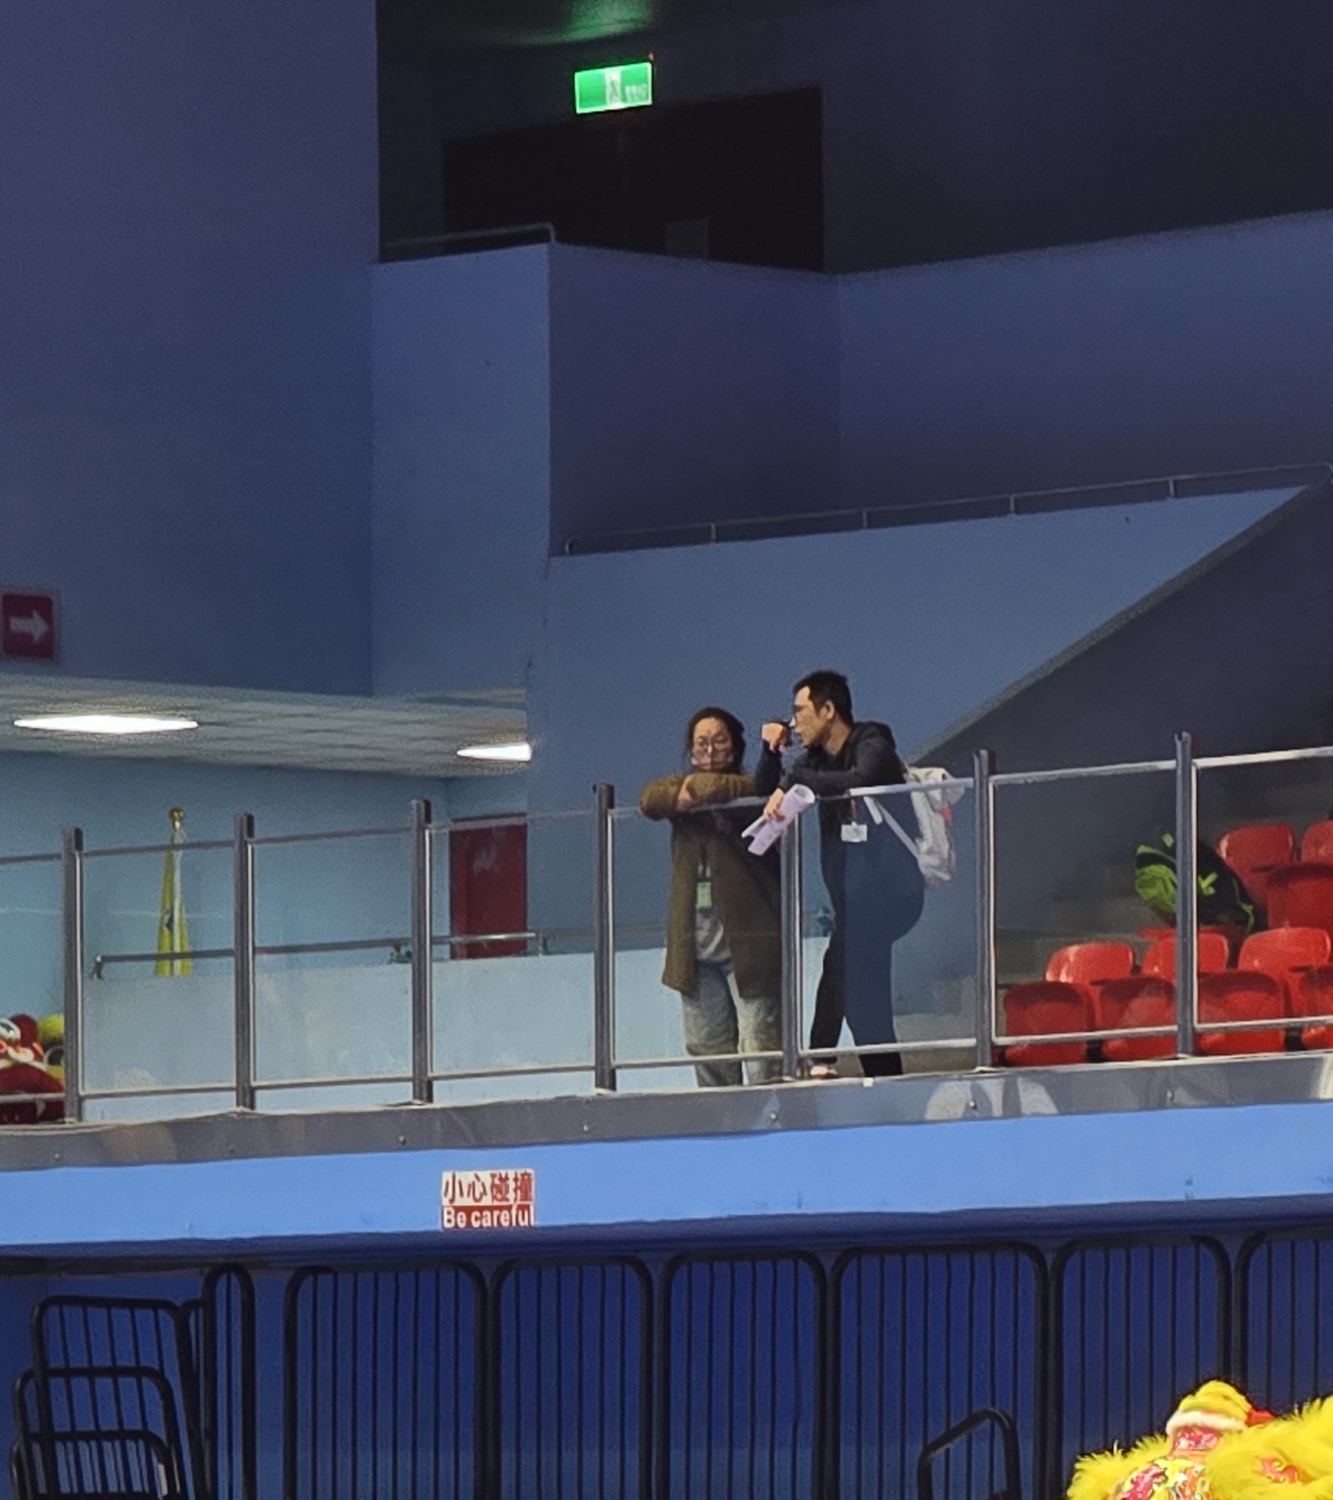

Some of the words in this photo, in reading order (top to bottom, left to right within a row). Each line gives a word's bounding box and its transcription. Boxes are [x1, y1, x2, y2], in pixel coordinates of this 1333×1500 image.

[443, 1170, 533, 1204] 小心碰撞
[443, 1207, 467, 1229] Be
[470, 1203, 536, 1228] careful
